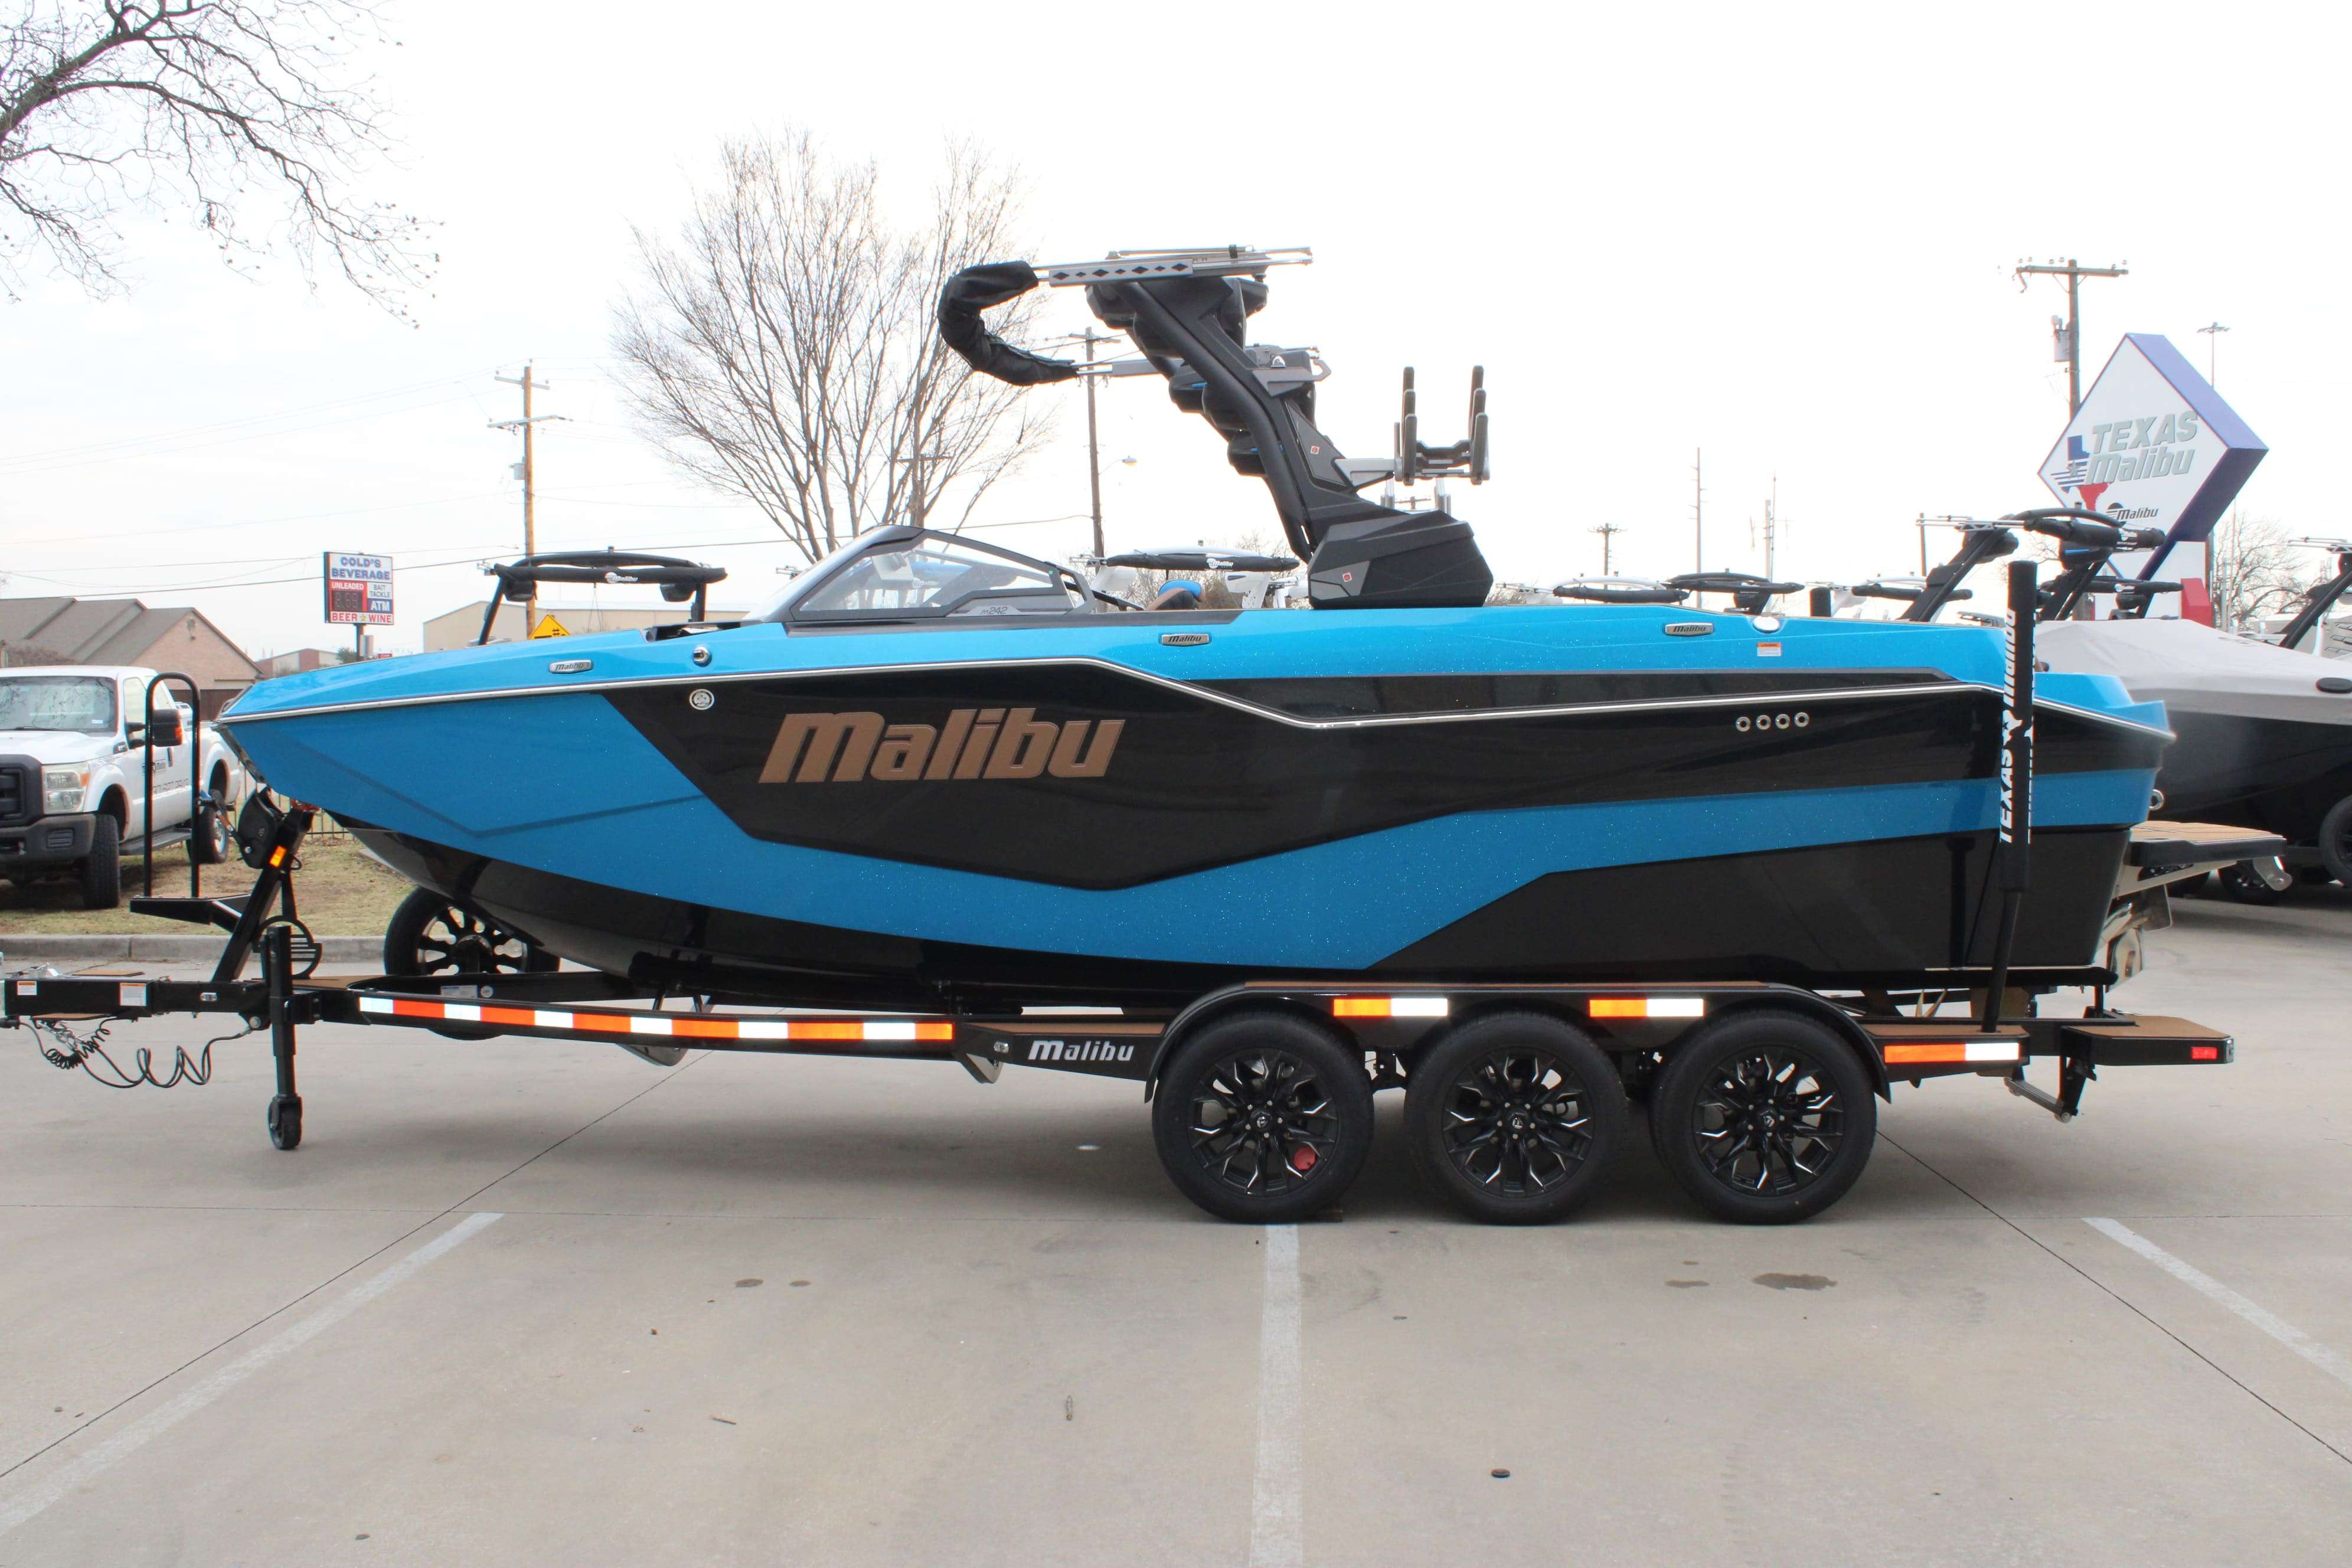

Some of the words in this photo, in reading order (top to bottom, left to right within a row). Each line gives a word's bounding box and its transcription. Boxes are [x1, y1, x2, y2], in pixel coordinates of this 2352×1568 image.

[2092, 410, 2199, 454] TEXAS
[2085, 447, 2197, 485] Malibu
[2116, 507, 2159, 520] Malibu
[341, 557, 381, 567] COLD'S
[331, 568, 390, 580] BEVERAGE
[331, 582, 364, 590] UNLEADED
[371, 600, 390, 612] ATM
[332, 613, 358, 622] BEER
[369, 614, 391, 623] WINE
[556, 662, 584, 671] Malibu
[757, 707, 1126, 783] Malibu
[1028, 1040, 1135, 1061] Malibu
